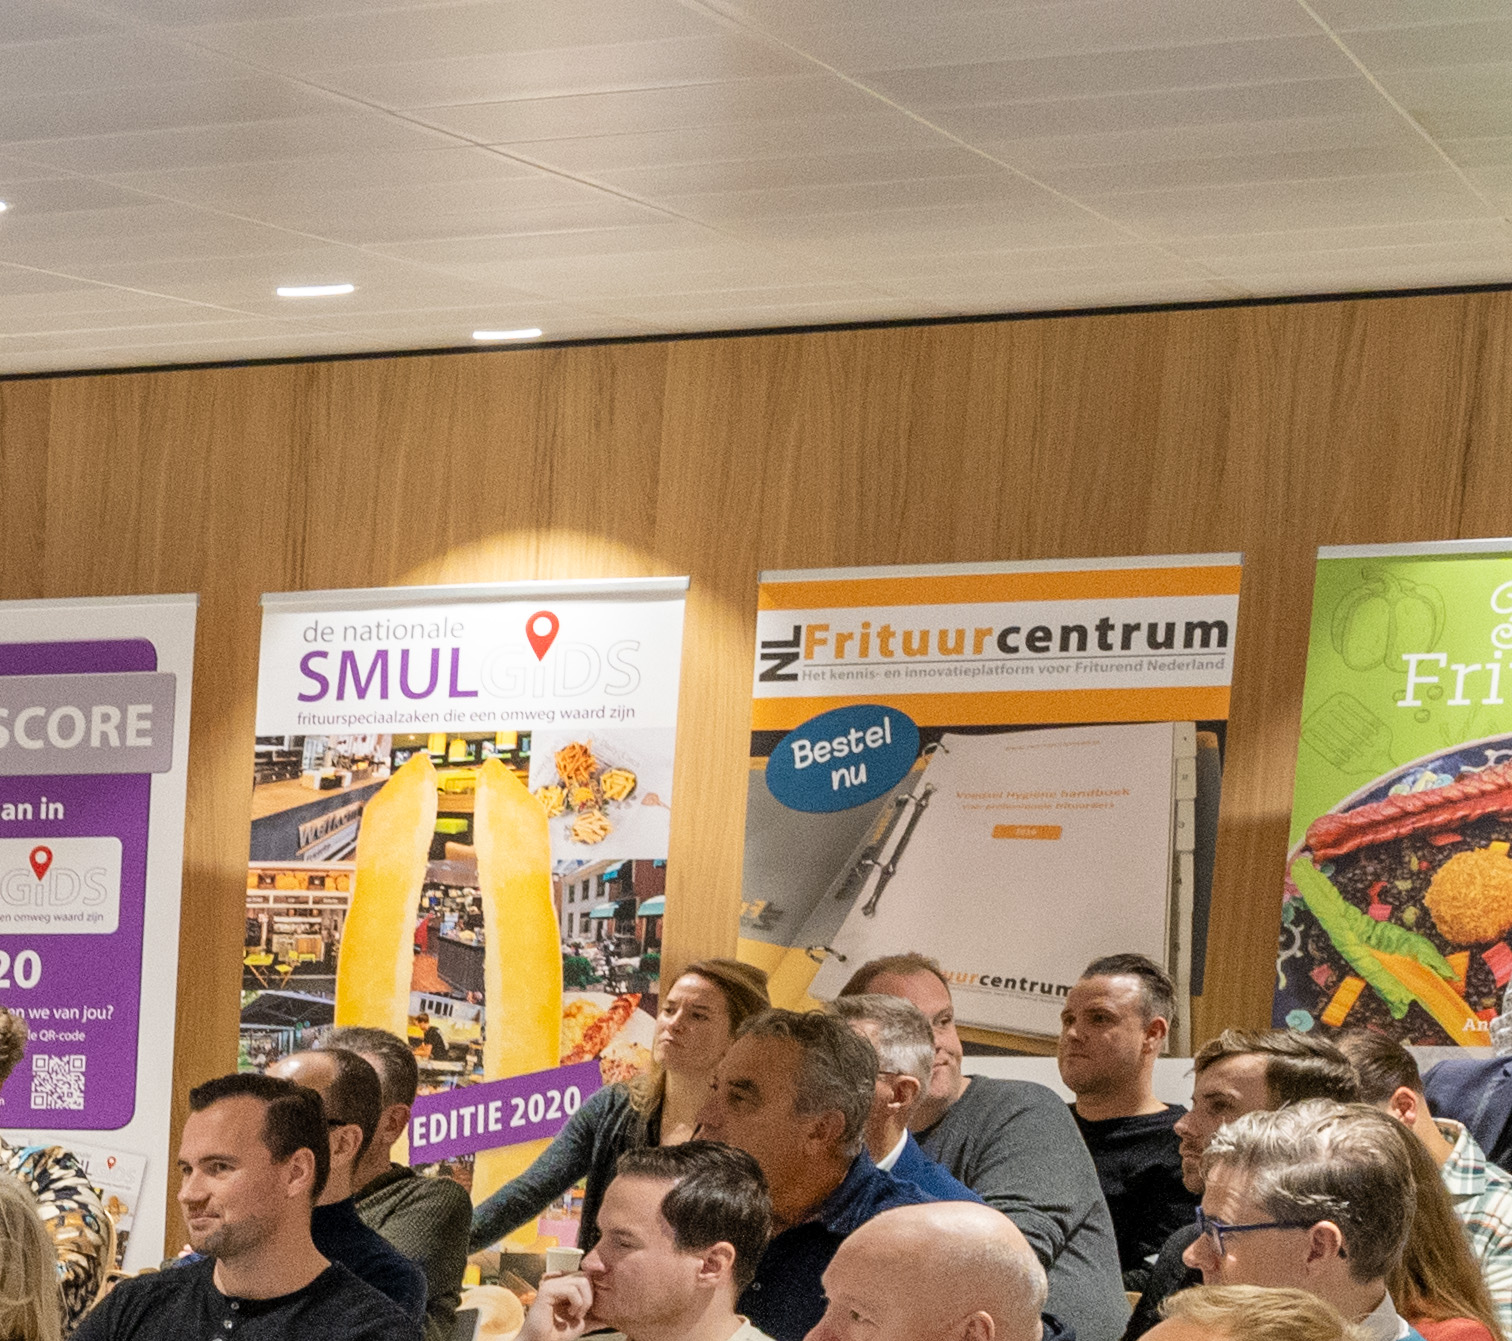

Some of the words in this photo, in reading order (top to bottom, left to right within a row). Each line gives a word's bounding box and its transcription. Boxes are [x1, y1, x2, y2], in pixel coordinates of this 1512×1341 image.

[302, 620, 334, 643] de
[343, 617, 464, 642] nationale
[804, 616, 1229, 660] Frituurcentrum
[759, 624, 802, 682] NL
[802, 670, 826, 681] Het
[830, 668, 879, 681] kennis-
[884, 669, 901, 679] en
[905, 663, 1034, 681] innovatieplatform
[1039, 664, 1071, 675] voor
[1074, 660, 1143, 674] Friturend
[1147, 658, 1226, 672] Nederland
[1397, 652, 1512, 707] Fri
[297, 710, 439, 728] frituurspeciaalzaken
[447, 709, 465, 723] die
[470, 710, 496, 722] een
[500, 710, 555, 723] omweg
[560, 706, 605, 720] waard
[609, 706, 635, 723] zijn
[791, 715, 892, 769] Bestel
[831, 763, 867, 791] nu
[40, 796, 64, 820] in
[28, 1008, 50, 1020] we
[53, 1008, 79, 1020] van
[82, 1005, 114, 1023] jou?
[39, 1031, 86, 1042] QR-code
[413, 1100, 502, 1147] EDITIE
[510, 1086, 581, 1127] 2020
